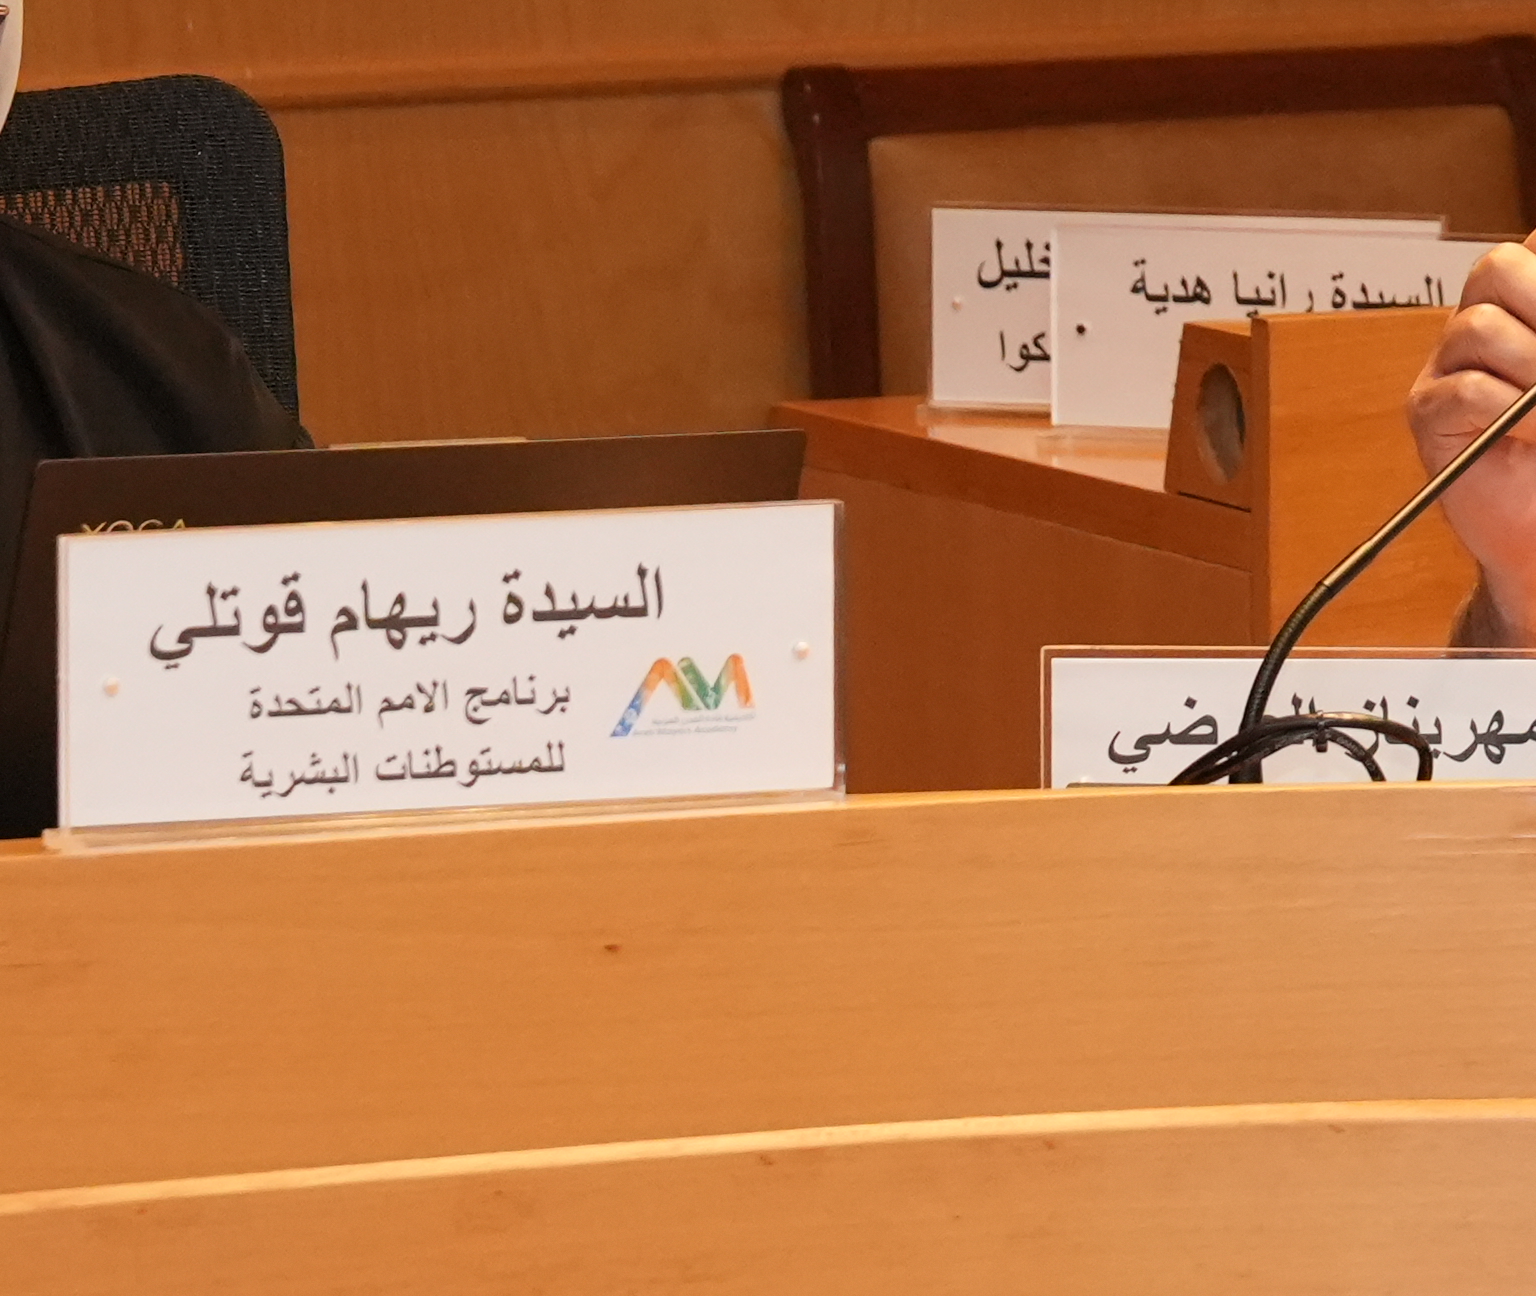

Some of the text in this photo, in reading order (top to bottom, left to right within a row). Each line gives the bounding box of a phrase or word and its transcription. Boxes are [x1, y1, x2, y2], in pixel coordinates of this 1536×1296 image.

[1130, 258, 1212, 316] هدية
[1232, 270, 1315, 319] رانيا
[149, 562, 663, 670] السيدة ريهام قوتلي
[249, 675, 570, 730] برنامج الامم المتحدة
[239, 741, 565, 799] للمستوطنات البشرية
